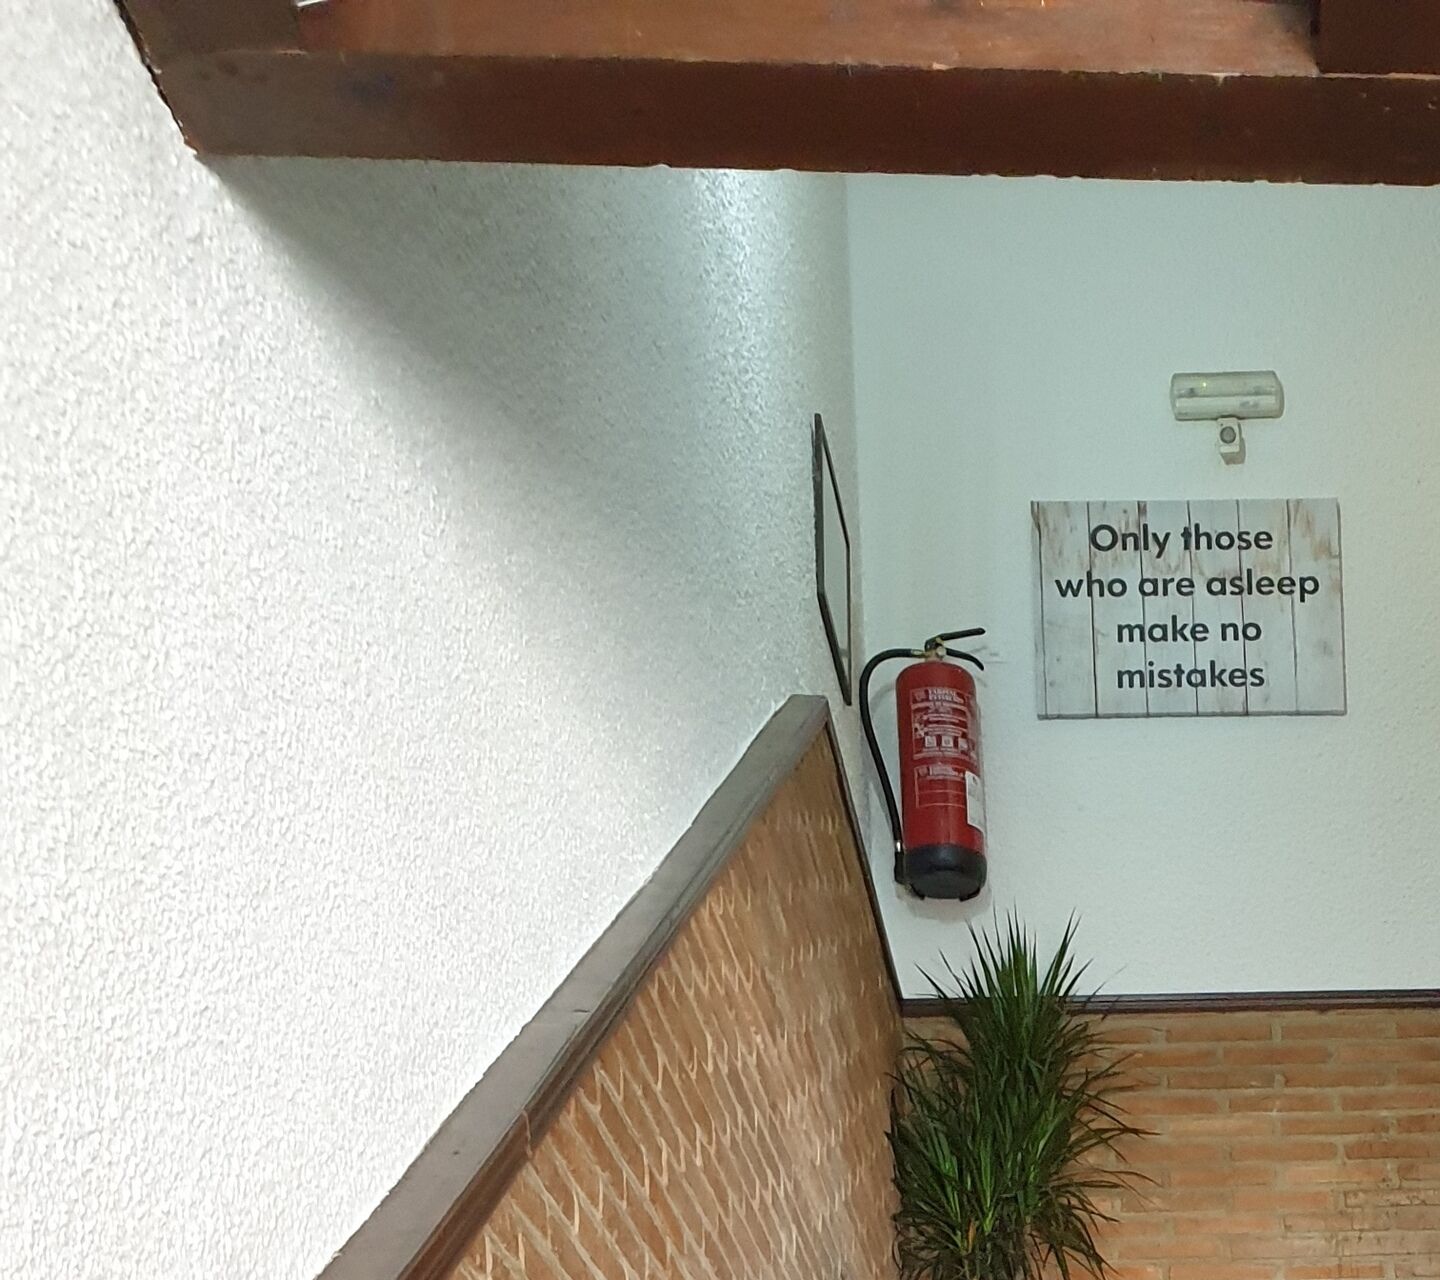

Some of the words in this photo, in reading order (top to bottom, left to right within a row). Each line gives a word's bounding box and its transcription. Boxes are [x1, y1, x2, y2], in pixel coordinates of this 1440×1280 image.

[1091, 523, 1171, 558] Only
[1181, 523, 1273, 551] those
[1055, 571, 1127, 598] who
[1138, 577, 1195, 597] are
[1206, 568, 1320, 602] asleep
[1117, 615, 1209, 643] make
[1221, 620, 1262, 642] no
[1117, 660, 1265, 688] mistakes
